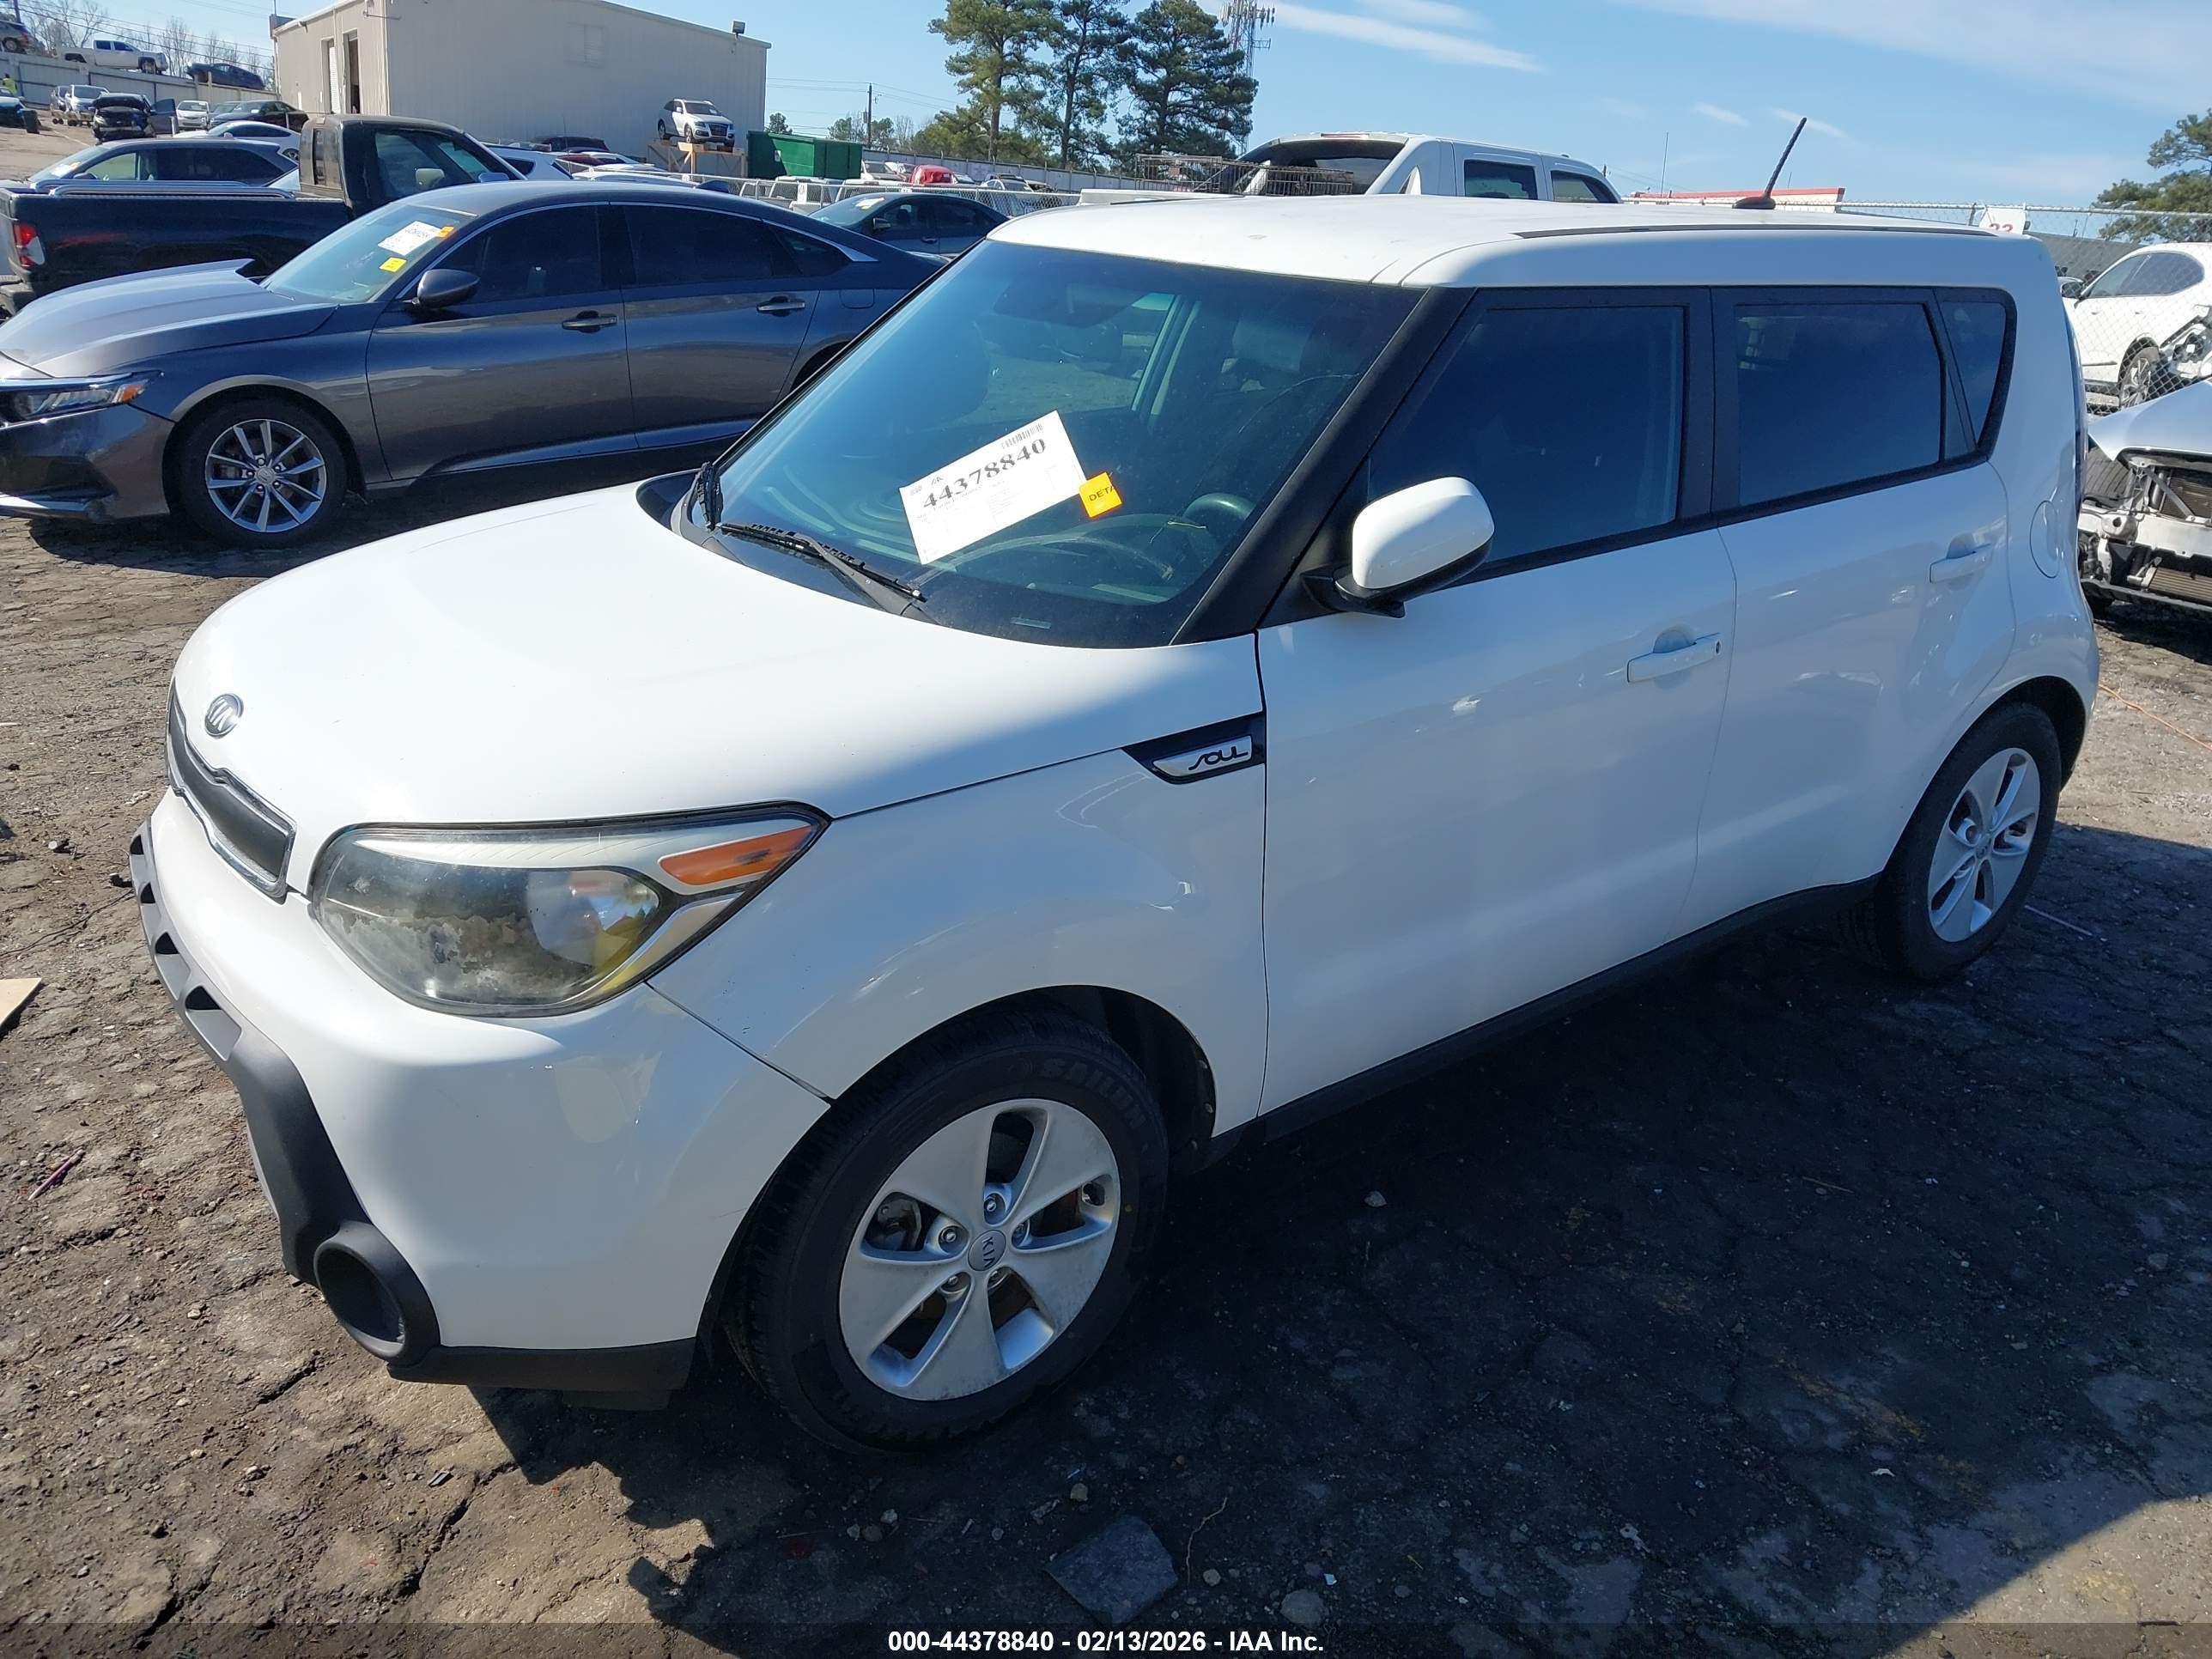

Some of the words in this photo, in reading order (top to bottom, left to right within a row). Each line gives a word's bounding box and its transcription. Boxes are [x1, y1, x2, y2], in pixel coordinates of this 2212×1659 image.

[923, 438, 1047, 508] 44378840
[1188, 745, 1249, 771] SOUL
[981, 1236, 996, 1269] KIA
